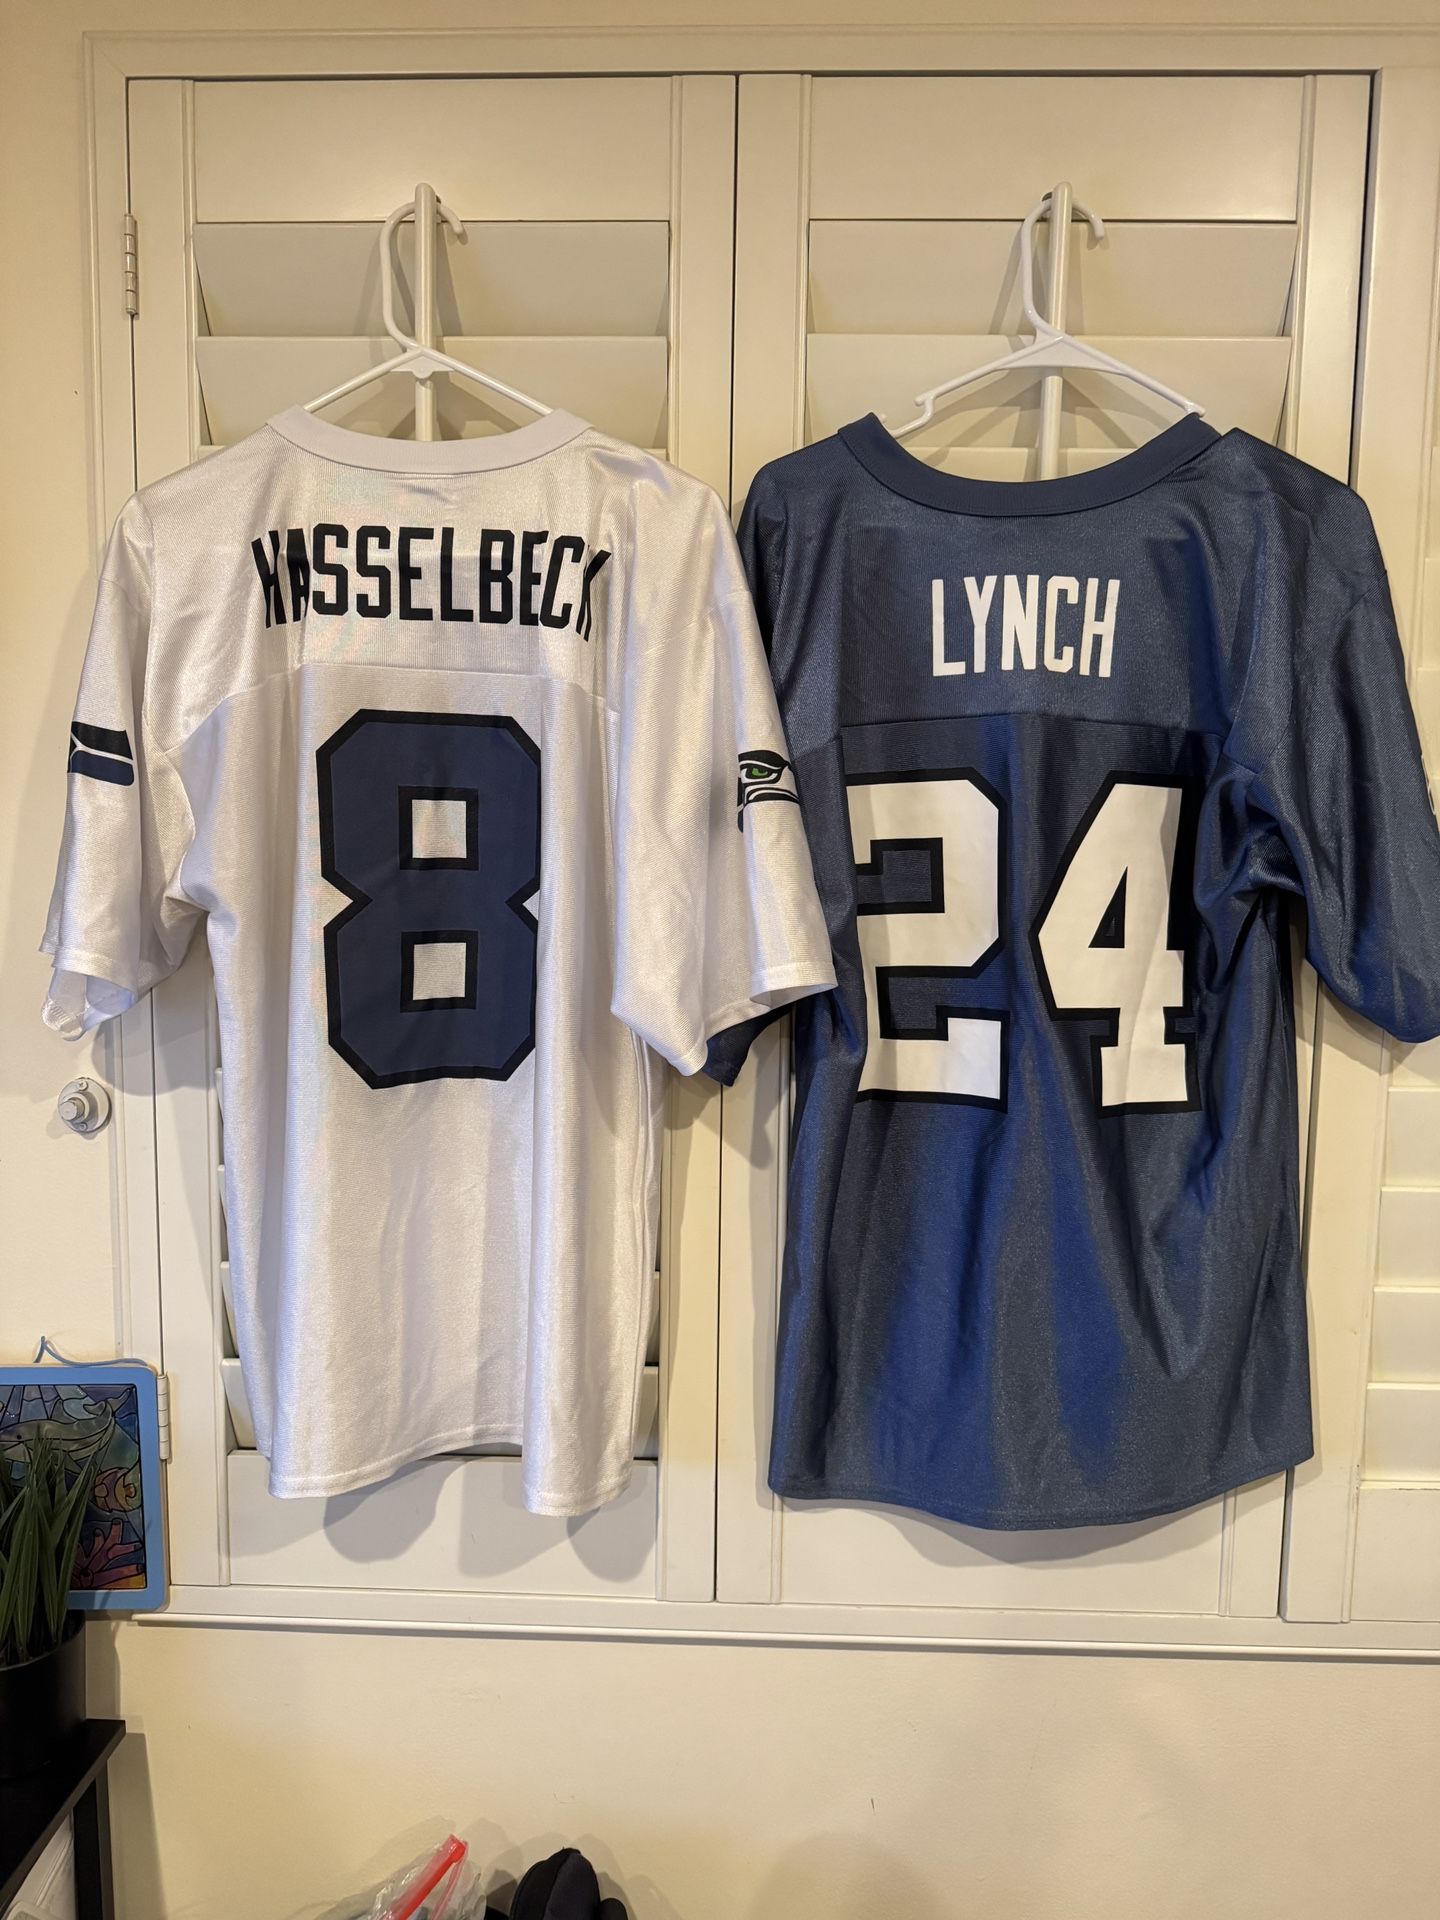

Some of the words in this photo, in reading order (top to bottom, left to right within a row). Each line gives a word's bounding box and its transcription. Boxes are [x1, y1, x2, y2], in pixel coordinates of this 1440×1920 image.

[251, 523, 611, 642] HASSELBECK
[932, 575, 1120, 678] LYNCH
[316, 709, 541, 1089] 8
[845, 767, 1203, 1117] 24
